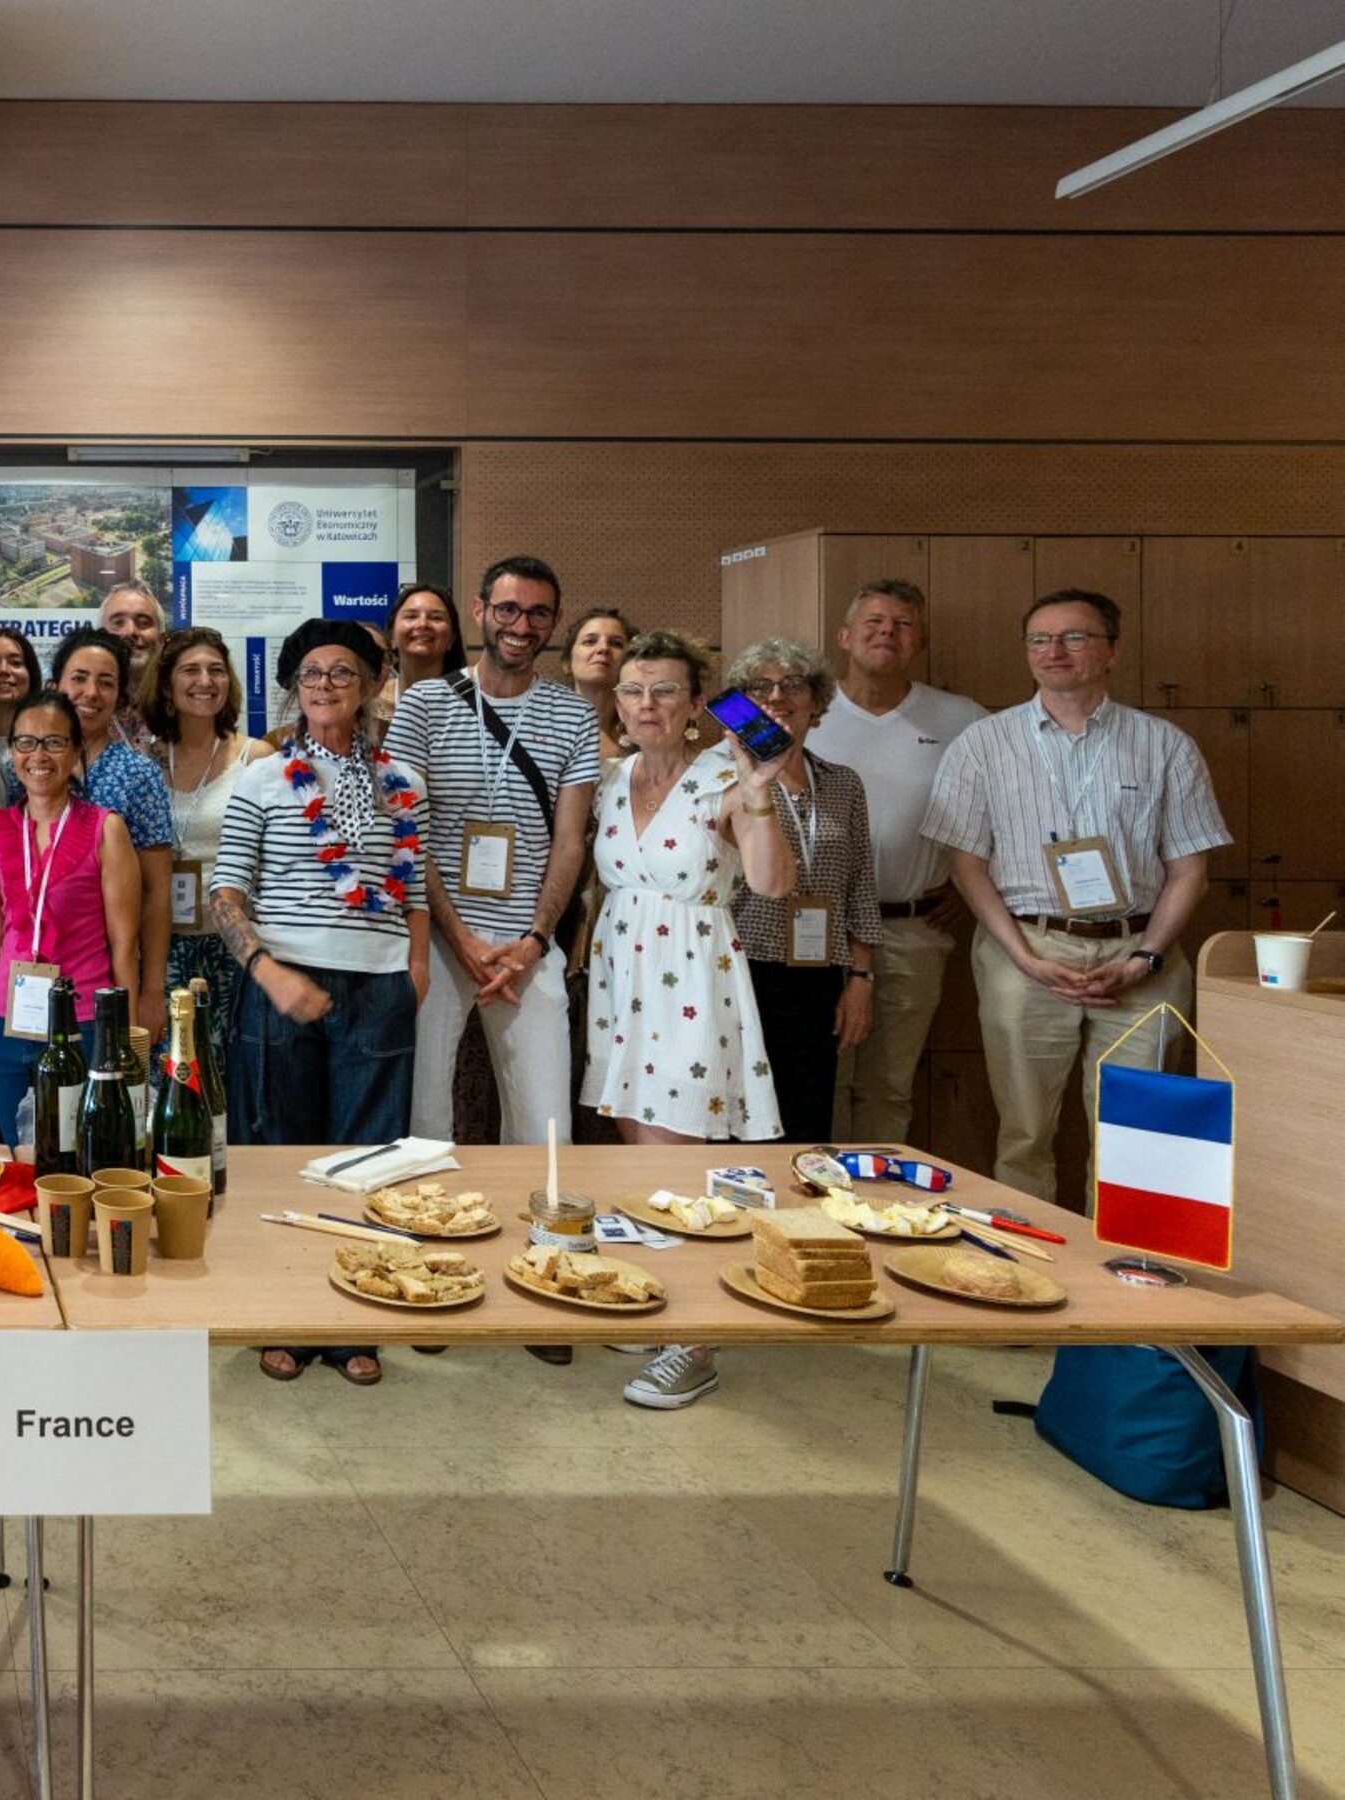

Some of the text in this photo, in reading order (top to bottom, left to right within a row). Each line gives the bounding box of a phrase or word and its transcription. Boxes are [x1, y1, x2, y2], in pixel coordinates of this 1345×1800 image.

[316, 509, 377, 519] Uniwersytet
[316, 520, 378, 530] Ekonomiczny
[316, 532, 378, 541] w Katowicach
[333, 594, 388, 607] Wartości
[16, 1409, 134, 1437] France
